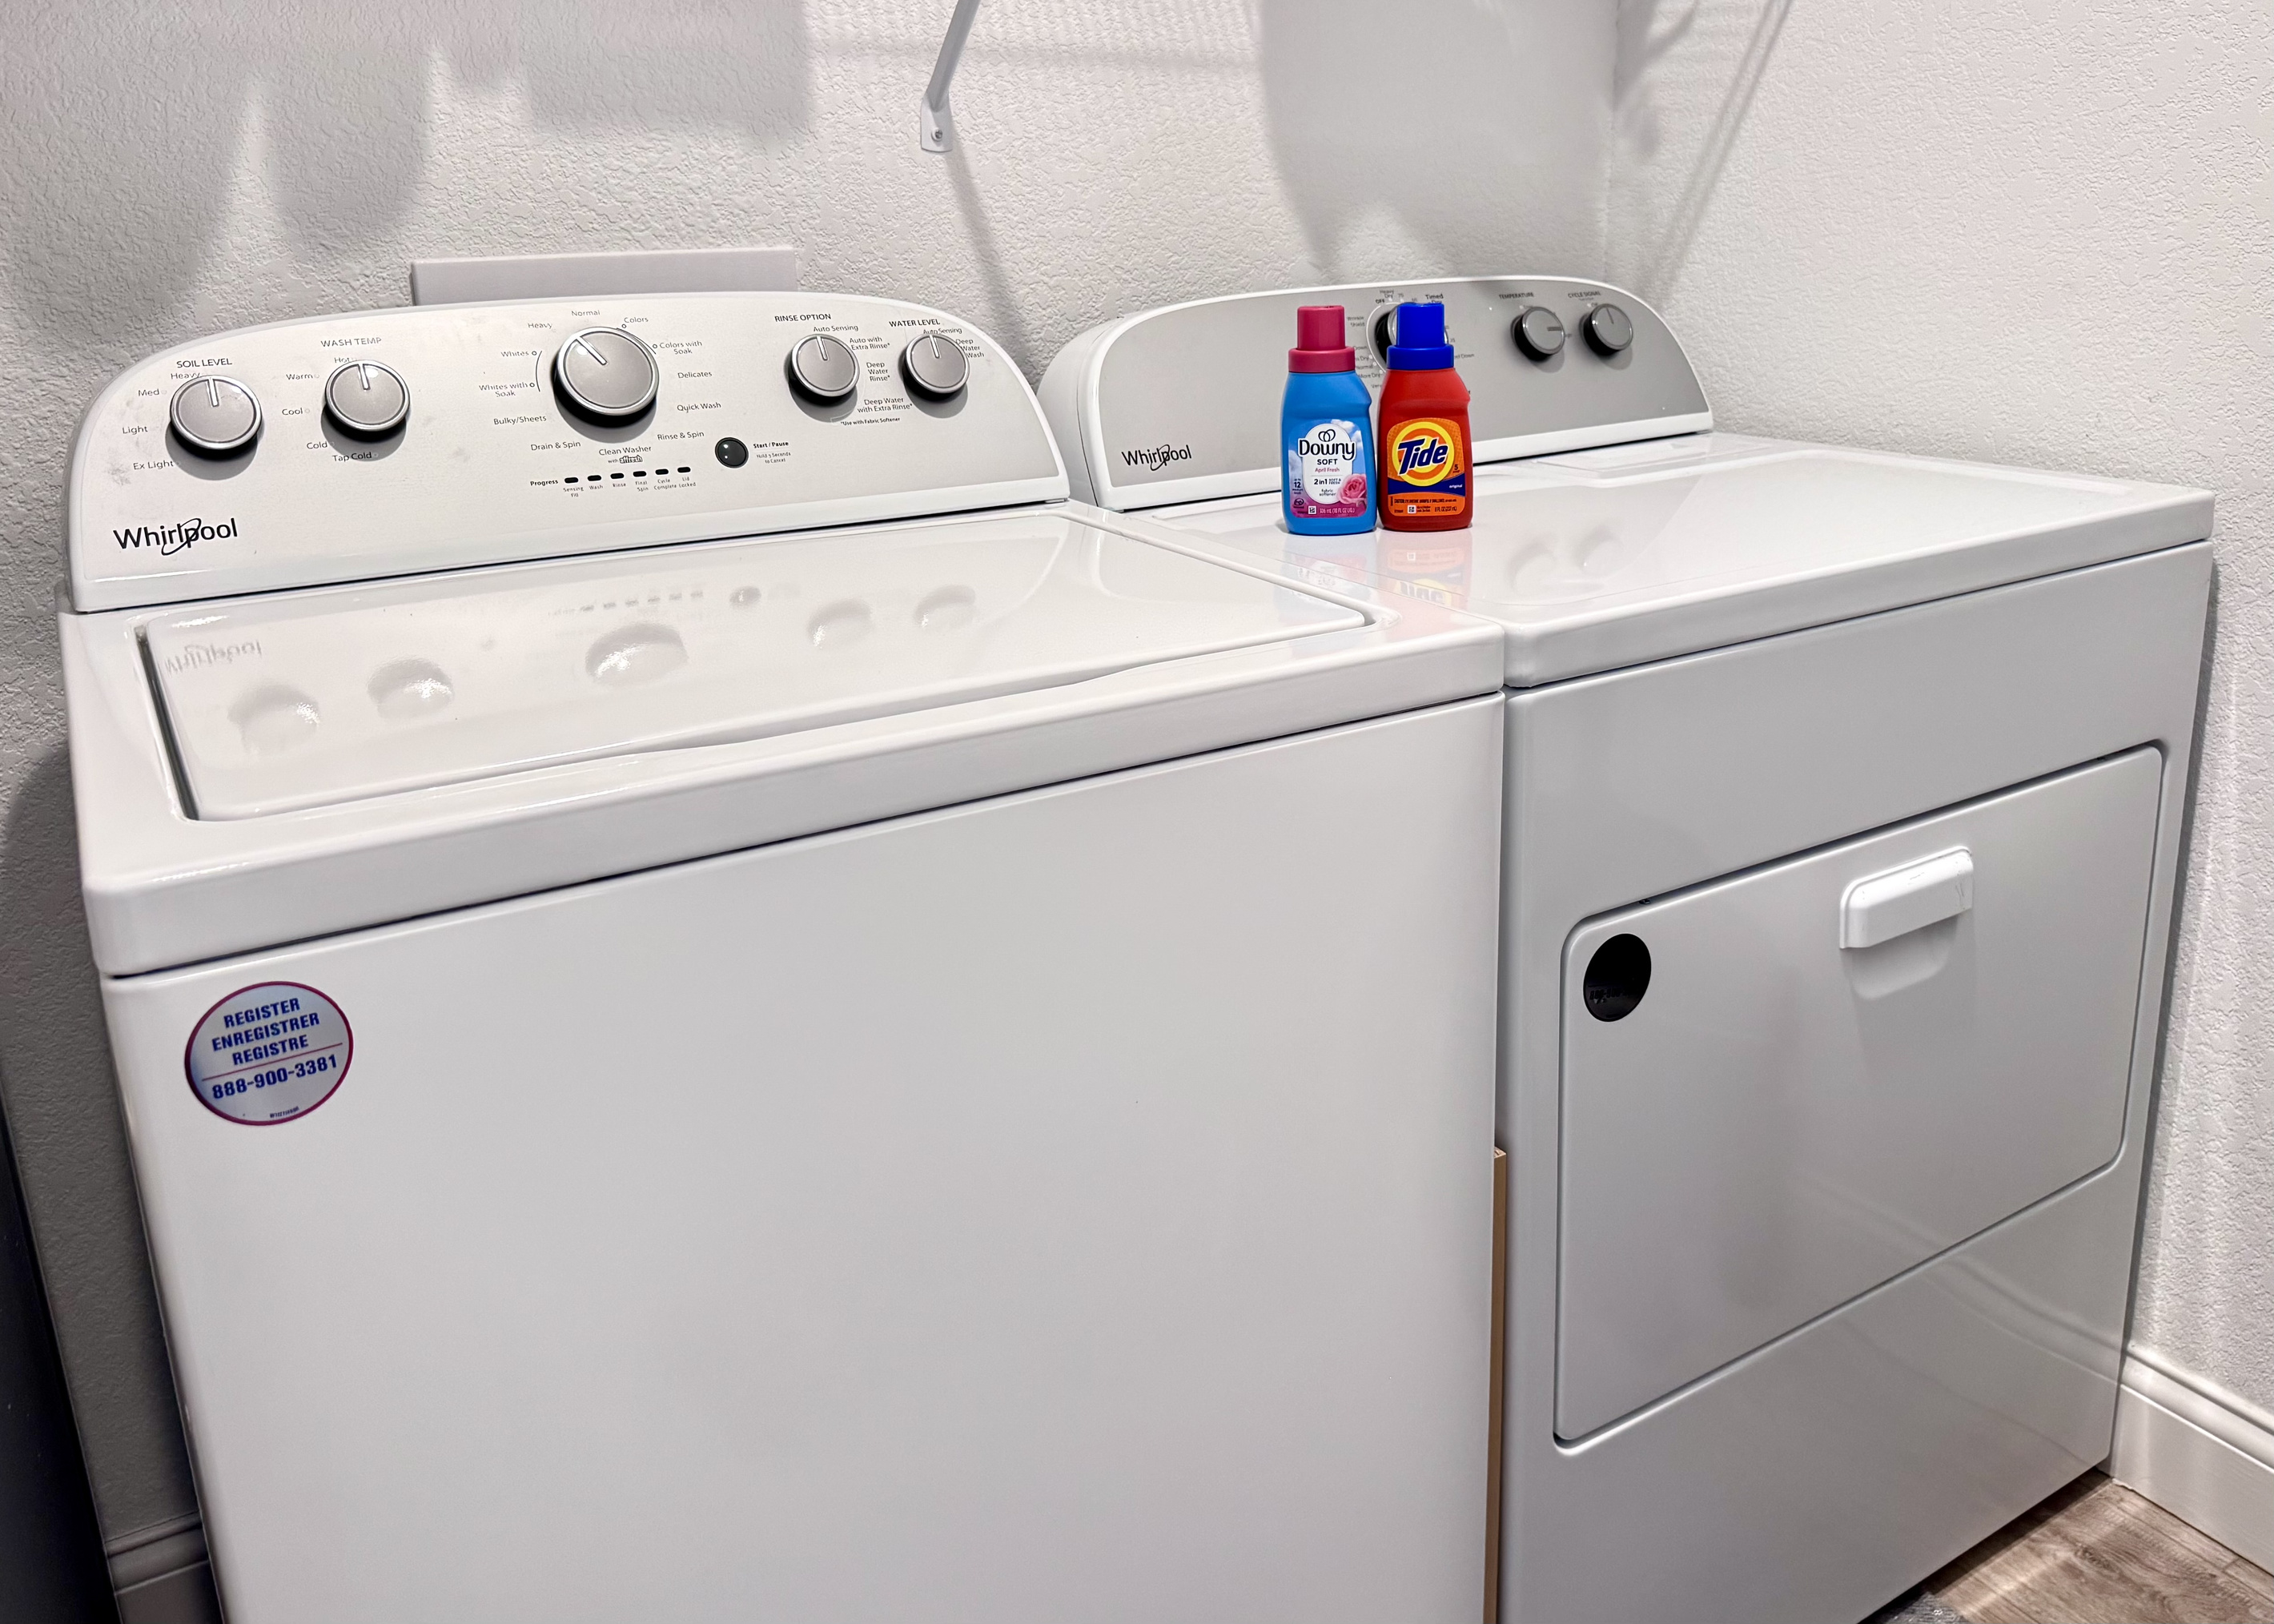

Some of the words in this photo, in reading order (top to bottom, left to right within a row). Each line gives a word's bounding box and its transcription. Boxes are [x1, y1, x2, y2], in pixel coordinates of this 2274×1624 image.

[1499, 291, 1534, 299] TEMPERATURE
[774, 315, 799, 323] RINSE
[799, 313, 832, 321] OPTION
[831, 324, 858, 332] Sensing
[320, 339, 352, 348] WASH
[354, 337, 382, 345] TEMP
[660, 341, 683, 349] Colors
[685, 340, 702, 348] with
[673, 347, 693, 355] Soak
[176, 360, 200, 368] SOIL
[202, 358, 233, 368] LEVEL
[677, 371, 713, 379] Delicates
[138, 388, 159, 396] Med
[479, 384, 508, 392] Whites
[496, 390, 516, 398] Soak
[282, 408, 303, 416] Cool
[677, 404, 699, 413] Quick
[699, 401, 721, 410] Wash
[493, 415, 547, 426] Bulky/Sheets
[123, 426, 148, 435] Light
[657, 432, 677, 441] Rinse
[687, 430, 705, 440] Spin
[306, 441, 327, 450] Cold
[530, 444, 553, 452] Drain
[562, 440, 581, 449] Spin
[599, 448, 621, 456] Clean
[623, 445, 653, 454] Washer
[1299, 439, 1355, 460] Downy
[331, 454, 350, 462] Tap
[351, 452, 372, 460] Cold
[619, 455, 643, 464] affresh
[1121, 444, 1191, 471] Whirlpool
[1398, 438, 1448, 475] Tide
[133, 462, 146, 471] Ex
[147, 459, 174, 471] Light
[113, 517, 239, 556] Whirlpool
[223, 998, 300, 1028] REGISTER
[211, 1012, 319, 1051] ENREGISTRER
[232, 1035, 309, 1065] REGISTRE
[211, 1054, 337, 1099] 888-900-3381
